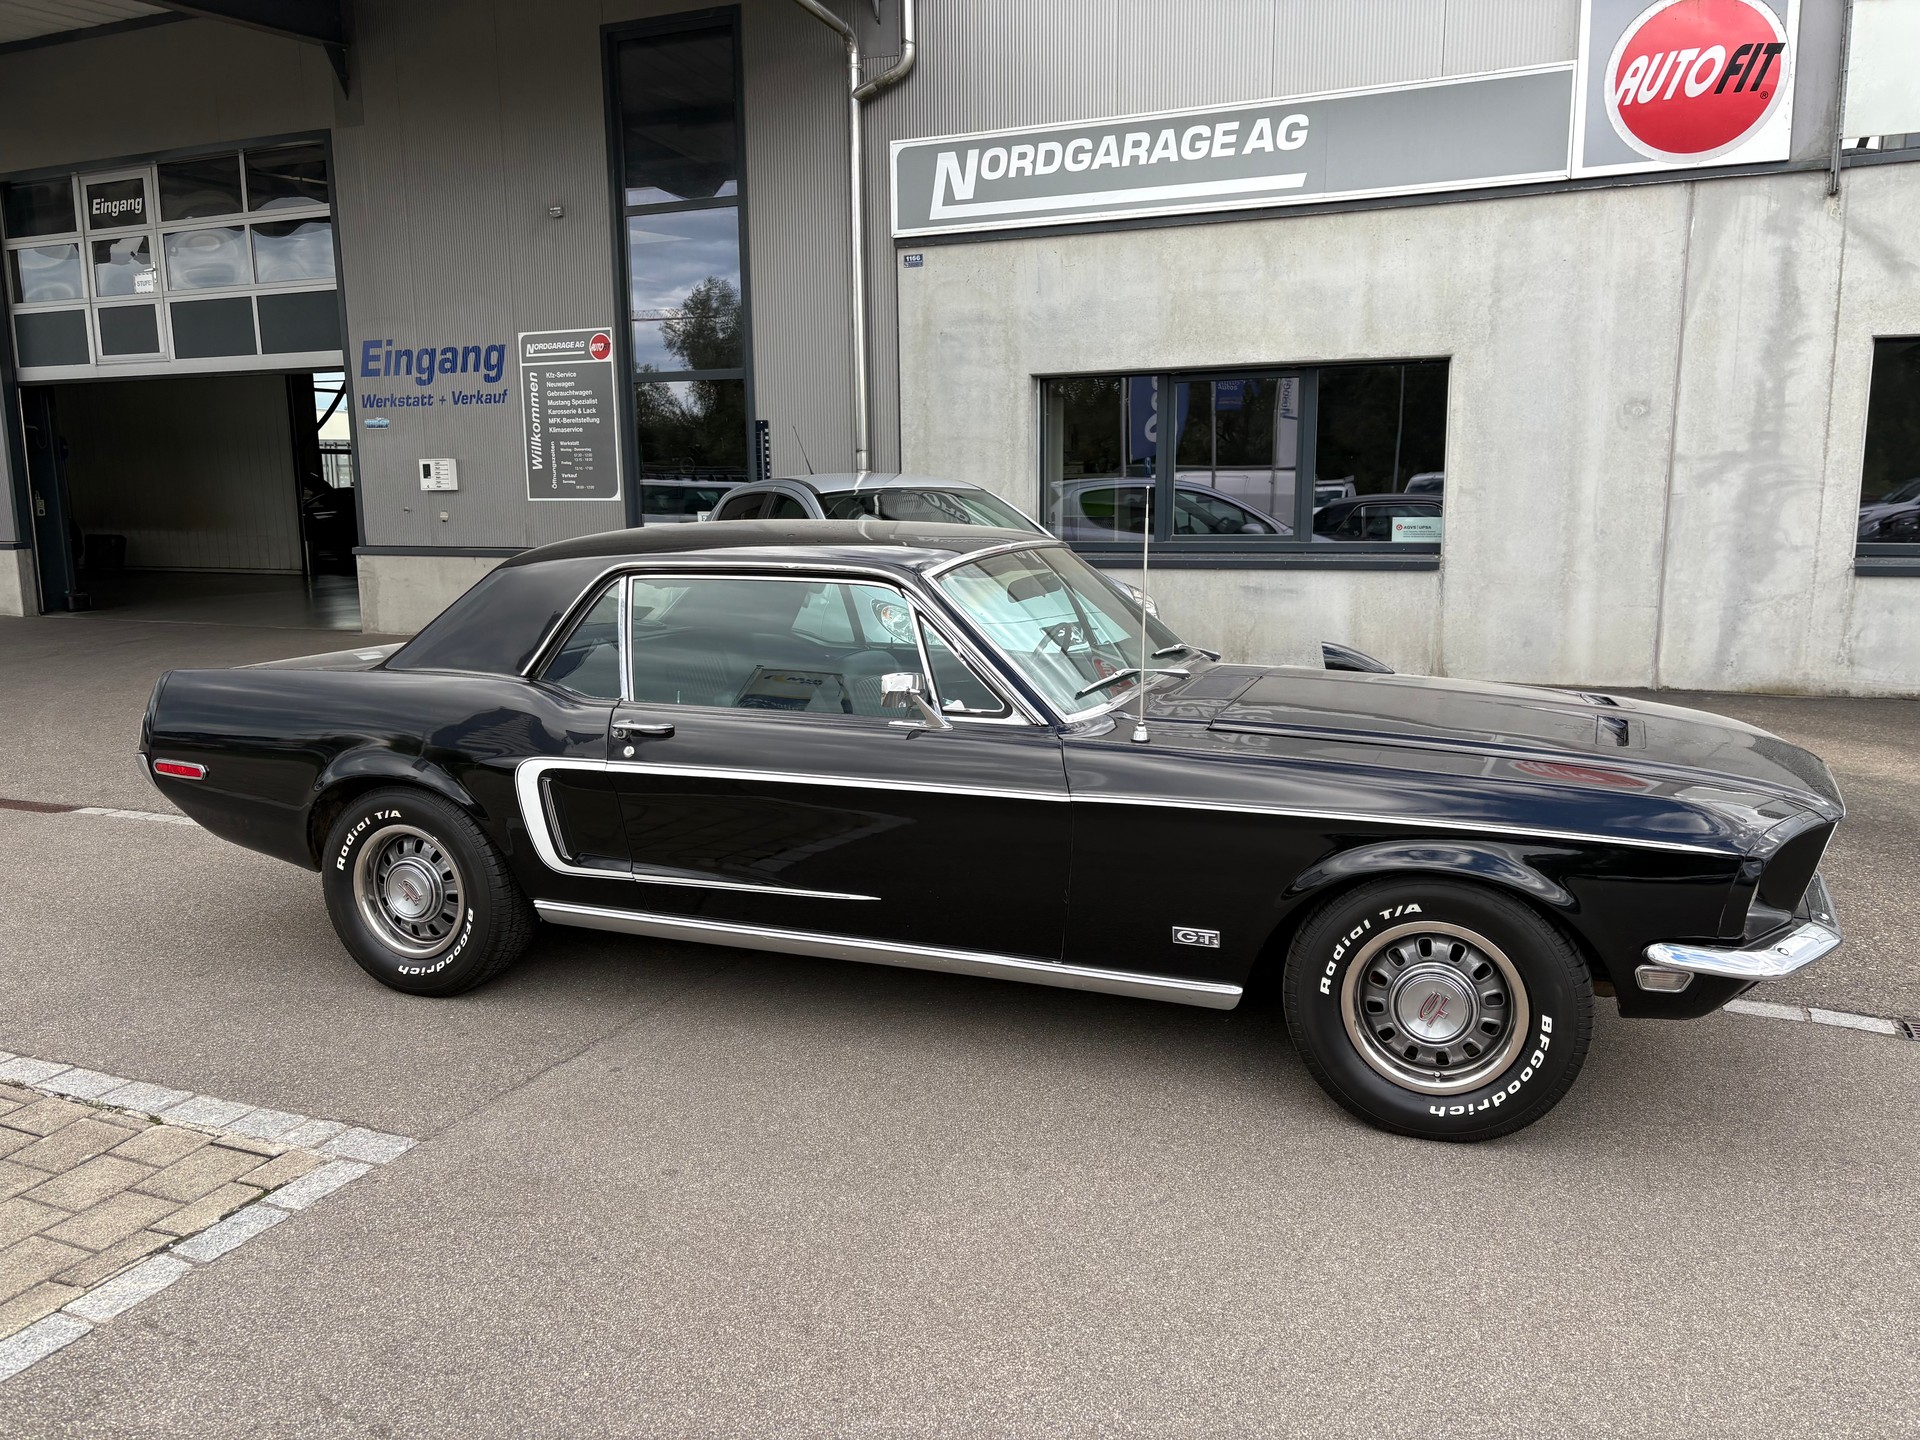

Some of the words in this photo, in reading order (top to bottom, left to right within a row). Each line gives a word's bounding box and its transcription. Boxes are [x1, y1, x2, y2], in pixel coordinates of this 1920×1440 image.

[1616, 43, 1786, 106] AUTOFIT
[931, 121, 1240, 207] NORDGARAGE
[1242, 113, 1310, 155] AG
[92, 197, 143, 217] Eingang
[360, 339, 506, 387] Eingang
[526, 341, 575, 355] NORDGARAGE
[545, 371, 577, 379] Kfz-Service
[546, 381, 575, 389] Neuwagen
[361, 394, 434, 409] Werkstatt
[439, 395, 447, 406] +
[452, 388, 508, 406] Verkauf
[547, 399, 571, 407] Mustang
[571, 398, 598, 406] Spezialist
[529, 371, 543, 470] Willkommen
[548, 416, 600, 424] MFK-Bereitstellung
[336, 816, 371, 871] Radial
[374, 809, 402, 820] T/A
[397, 907, 475, 976] BFGoodrich
[1176, 930, 1216, 945] GT
[1319, 919, 1372, 995] Radial
[1379, 903, 1423, 921] T/A
[1429, 1013, 1553, 1118] BFGoodrich
